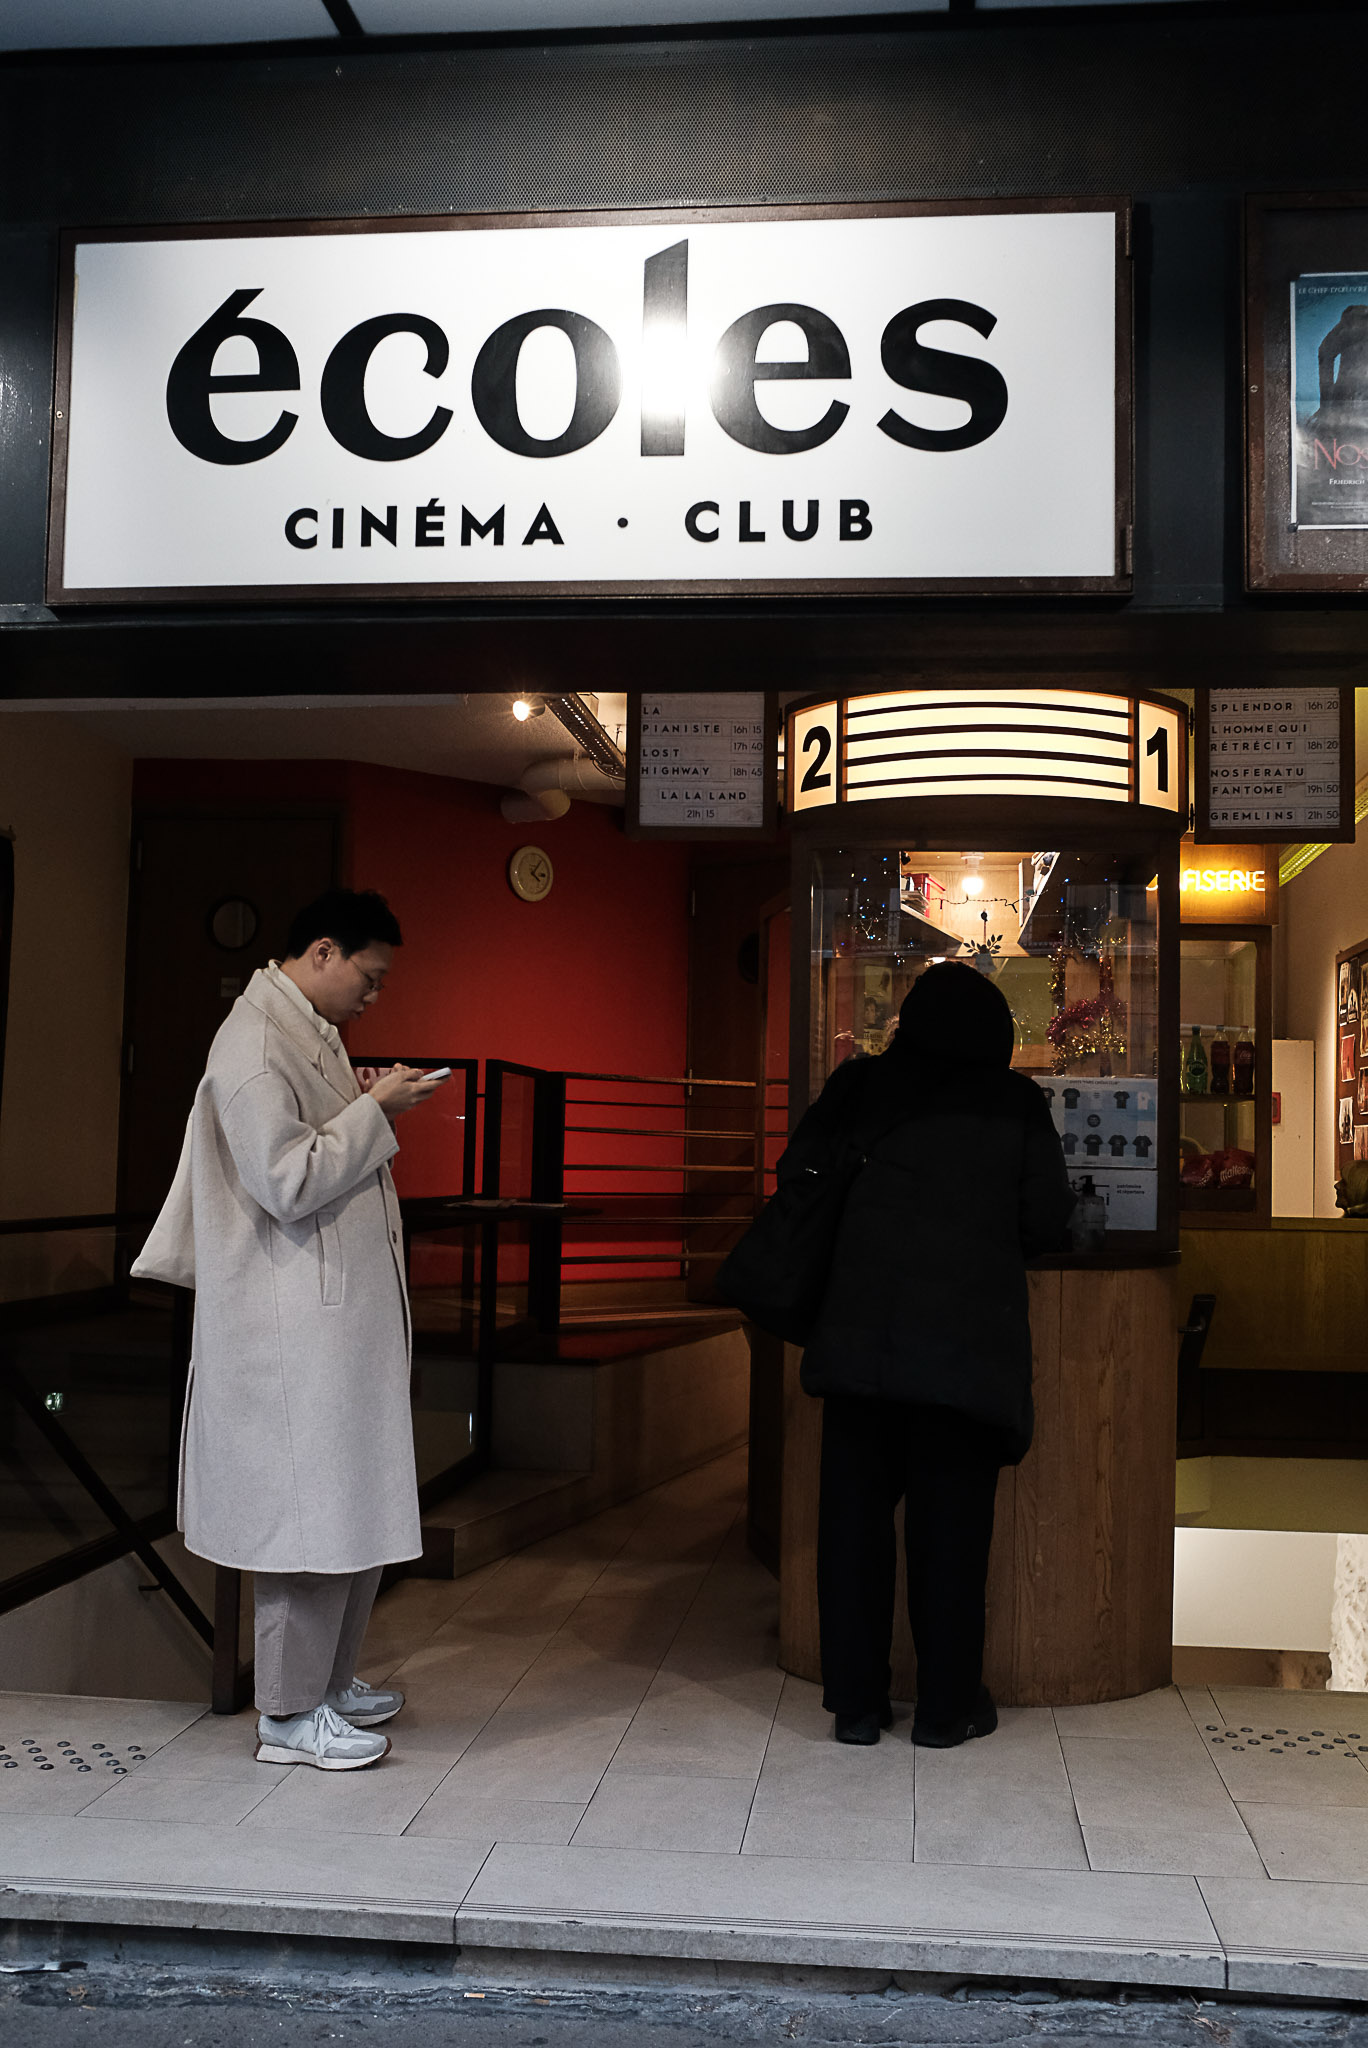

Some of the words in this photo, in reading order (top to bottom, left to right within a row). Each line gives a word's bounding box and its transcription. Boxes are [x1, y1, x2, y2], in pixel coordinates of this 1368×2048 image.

[166, 238, 1009, 466] écoles
[285, 498, 565, 549] CINÉMA
[685, 499, 873, 543] CLUB
[643, 707, 661, 715] LA
[1210, 702, 1294, 713] SPLENDOR
[1307, 702, 1323, 711] 16h
[1326, 700, 1339, 710] 20
[642, 724, 721, 734] PIANISTE
[733, 725, 748, 735] 16h
[752, 725, 762, 734] 15
[1278, 724, 1307, 733] QUI
[733, 742, 748, 751] 17h
[751, 742, 763, 751] 40
[1210, 740, 1294, 752] RÉTRÉCIT
[1307, 741, 1323, 750] 18h
[1326, 740, 1339, 750] 20
[642, 749, 680, 758] LOST
[801, 726, 831, 792] 2
[1146, 727, 1168, 792] 1
[641, 766, 710, 776] HIGHWAY
[733, 768, 747, 777] 18h
[751, 768, 763, 777] 45
[1210, 768, 1305, 778] NOSFERATU
[661, 791, 679, 800] LA
[685, 791, 702, 800] LA
[709, 791, 747, 800] LAND
[1212, 785, 1284, 796] FANTOME
[1307, 785, 1323, 794] 19h
[1326, 784, 1339, 794] 50
[686, 809, 701, 819] 21h
[705, 809, 715, 818] 15
[1210, 811, 1294, 822] GREMLINS
[1307, 811, 1323, 820] 21h
[1326, 810, 1339, 820] 50
[1179, 868, 1265, 892] FISERIE
